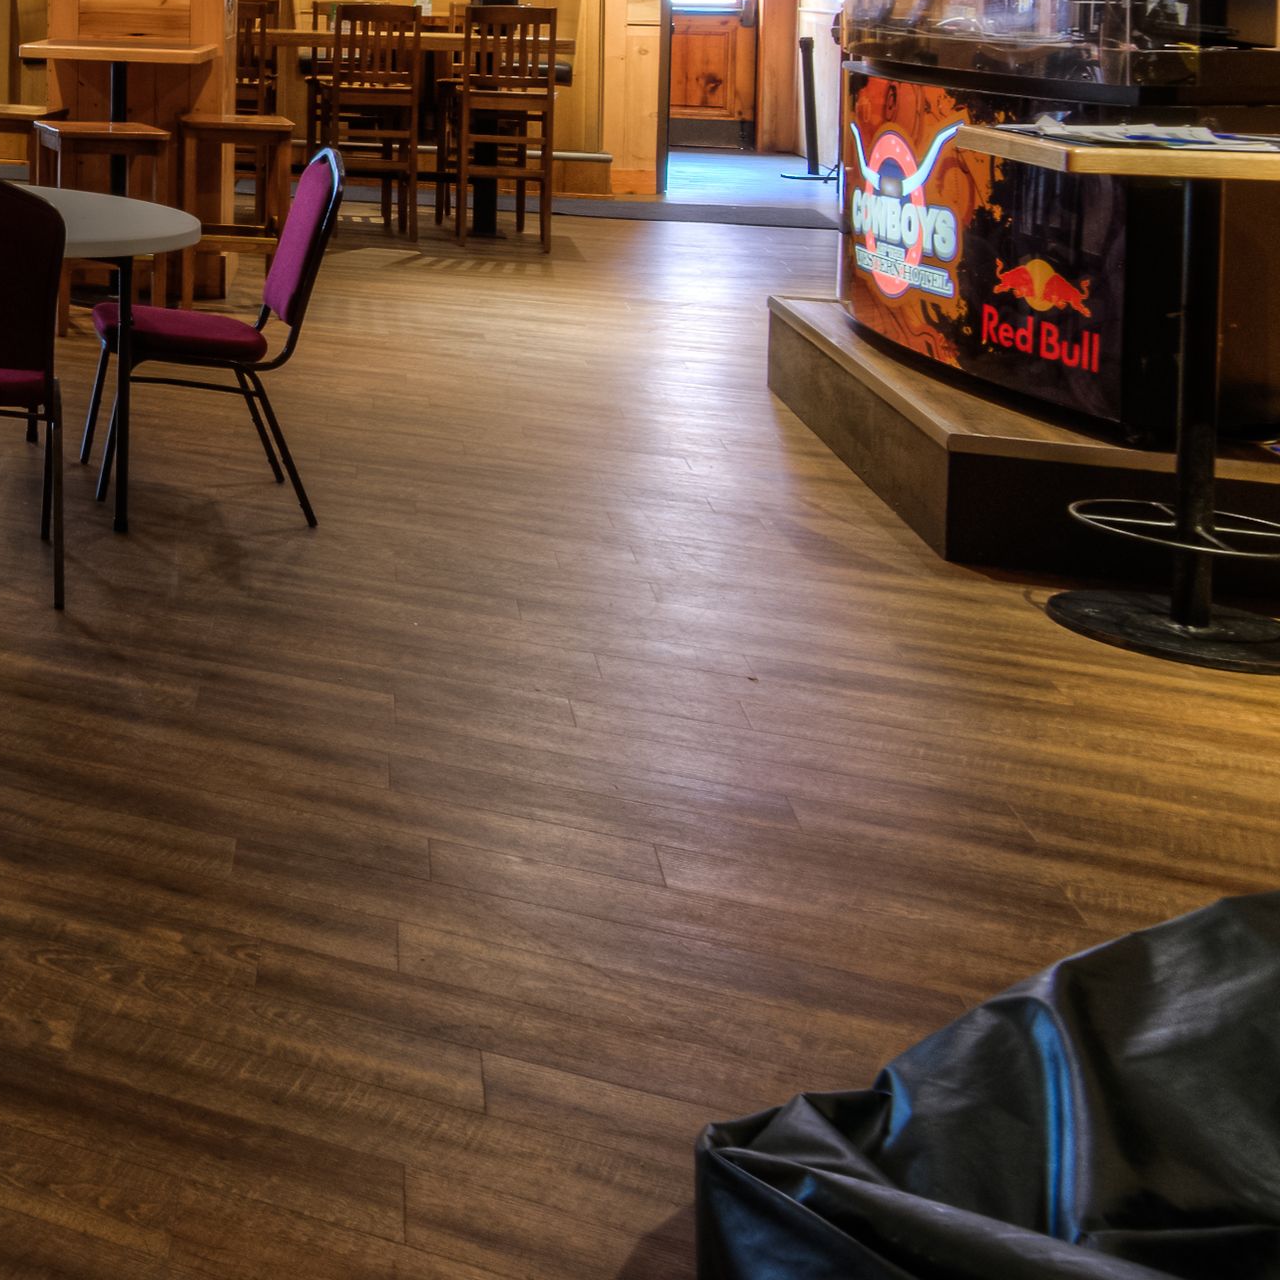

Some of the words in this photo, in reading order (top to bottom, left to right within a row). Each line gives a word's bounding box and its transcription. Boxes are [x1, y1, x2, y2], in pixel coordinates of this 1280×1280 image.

[852, 188, 957, 261] COWBOYS
[982, 303, 1034, 354] Red
[1040, 321, 1100, 374] Bull
